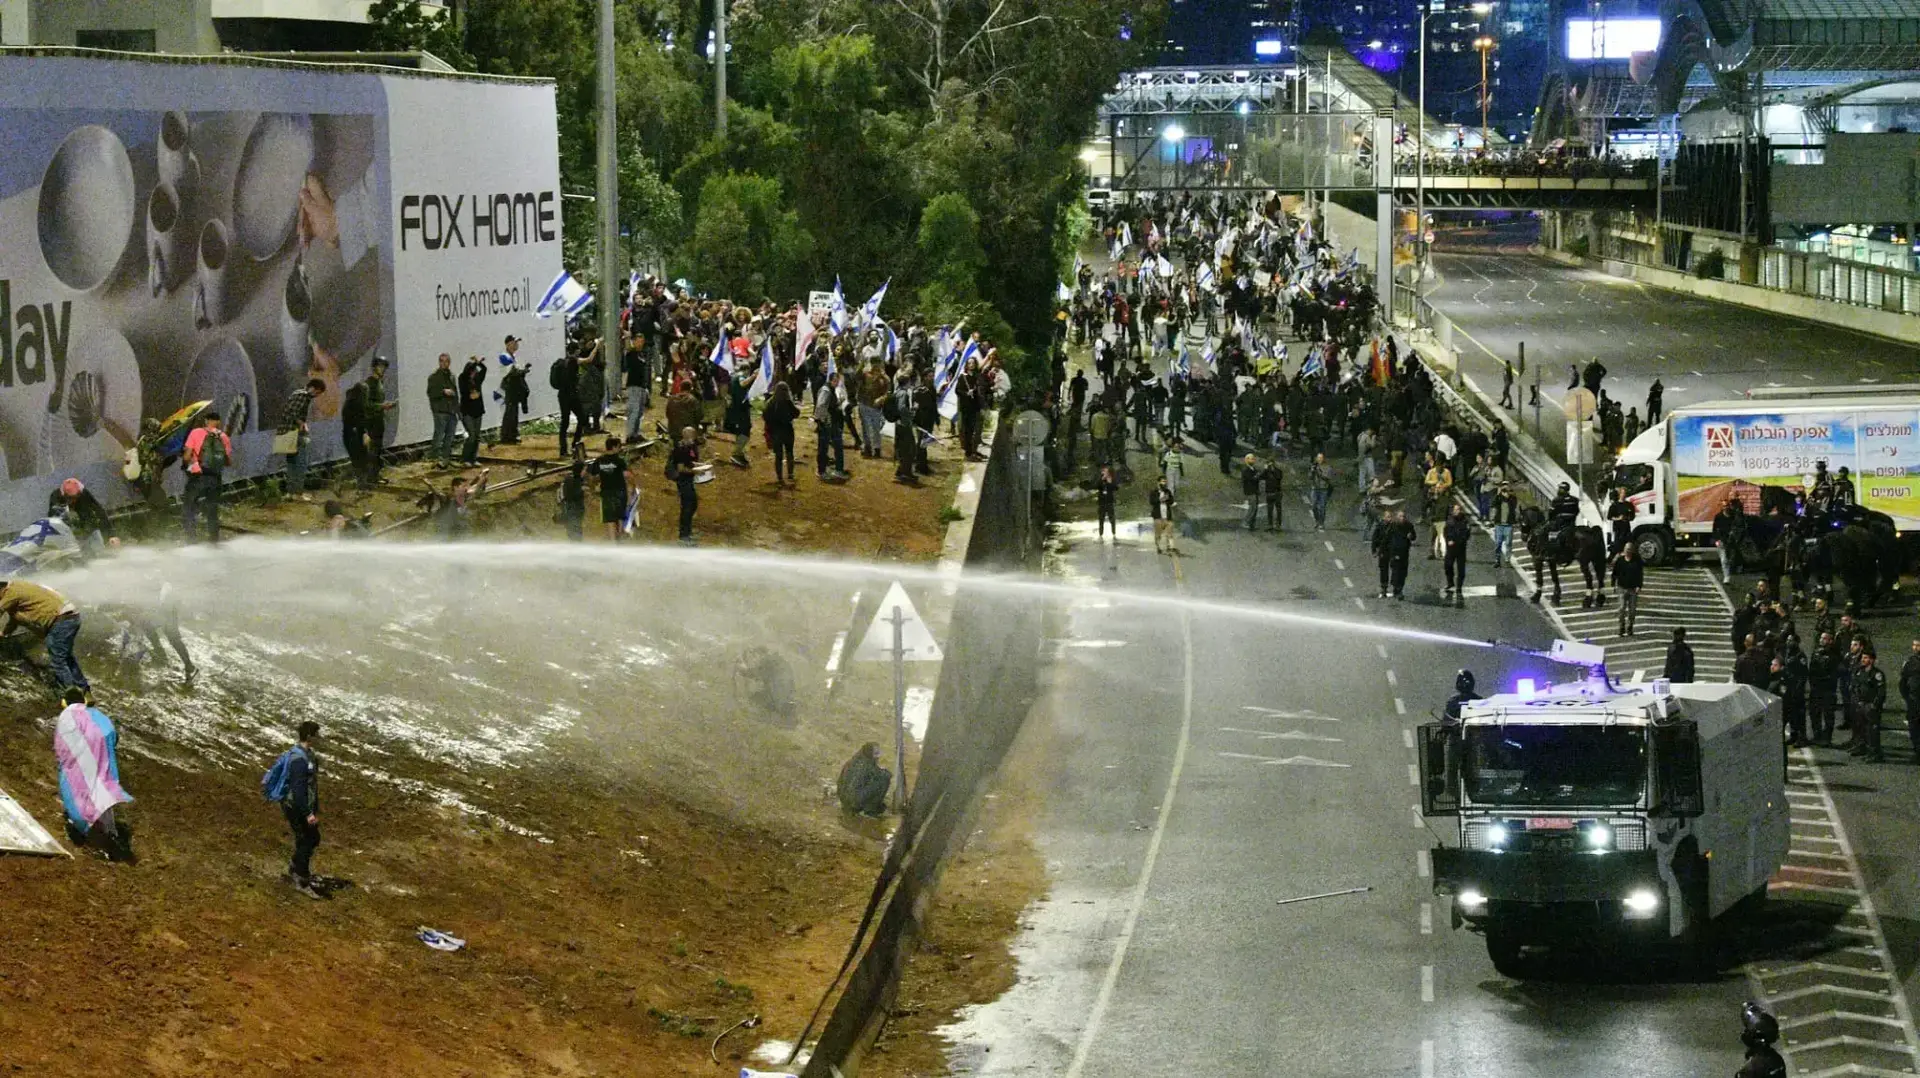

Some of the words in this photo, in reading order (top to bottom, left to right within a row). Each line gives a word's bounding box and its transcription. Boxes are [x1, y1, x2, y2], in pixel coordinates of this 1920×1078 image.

[401, 194, 466, 251] FOX
[473, 191, 555, 247] HOME
[436, 277, 531, 320] foxhome.co.il
[1740, 425, 1788, 440] הובלות
[1792, 427, 1829, 442] אפיק
[1865, 424, 1912, 436] מומלצים
[1709, 449, 1734, 459] אפיק
[1876, 466, 1905, 477] גופים
[1871, 487, 1911, 497] רשמיים
